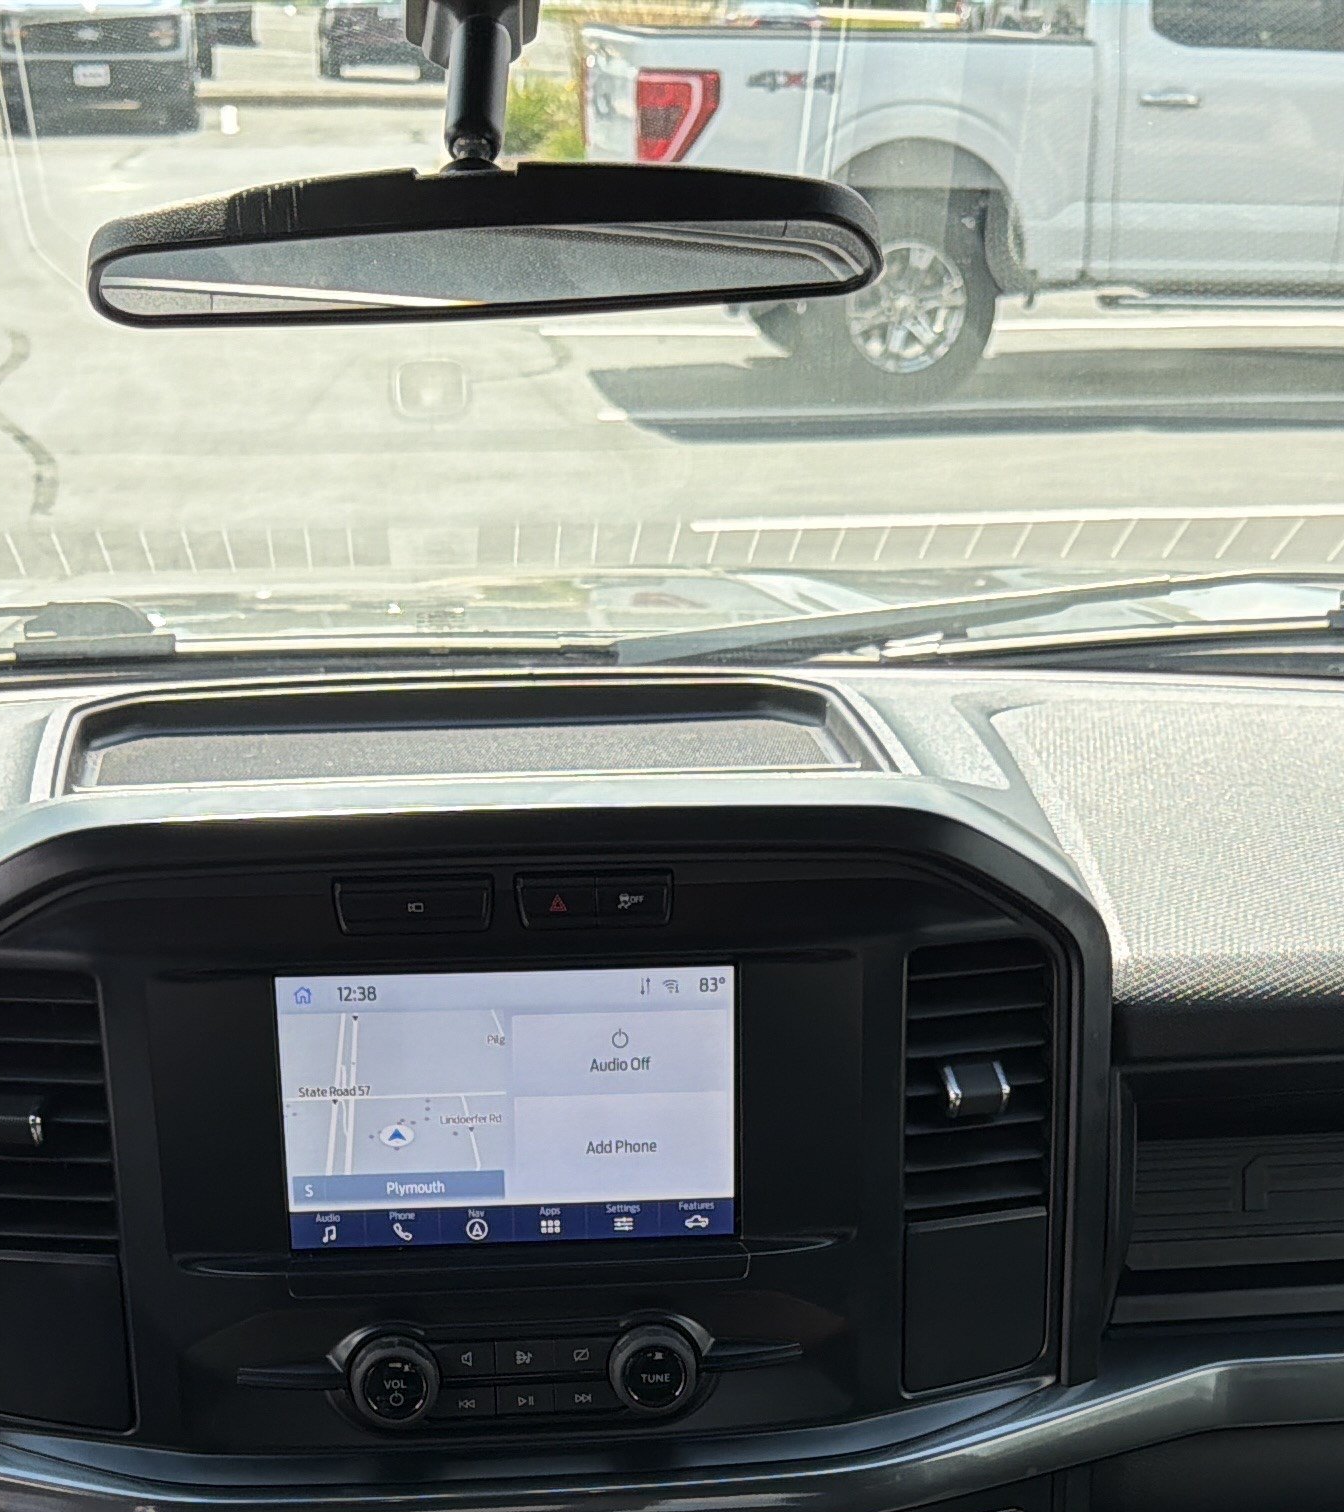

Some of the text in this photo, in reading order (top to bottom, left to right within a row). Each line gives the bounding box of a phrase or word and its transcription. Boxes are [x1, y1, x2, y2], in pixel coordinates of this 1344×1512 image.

[337, 986, 377, 1002] 12:38
[590, 1056, 651, 1072] Audio Off
[298, 1085, 371, 1098] State Road 57
[489, 1114, 502, 1124] Rd
[586, 1139, 657, 1154] Add Phone
[305, 1180, 445, 1198] S Plymouth
[606, 1203, 641, 1214] Settings
[678, 1201, 715, 1211] Features
[388, 1211, 416, 1221] Phone
[539, 1207, 561, 1217] Apps
[315, 1213, 341, 1223] Audio
[641, 1372, 671, 1384] TUNE
[383, 1379, 407, 1390] VOL
